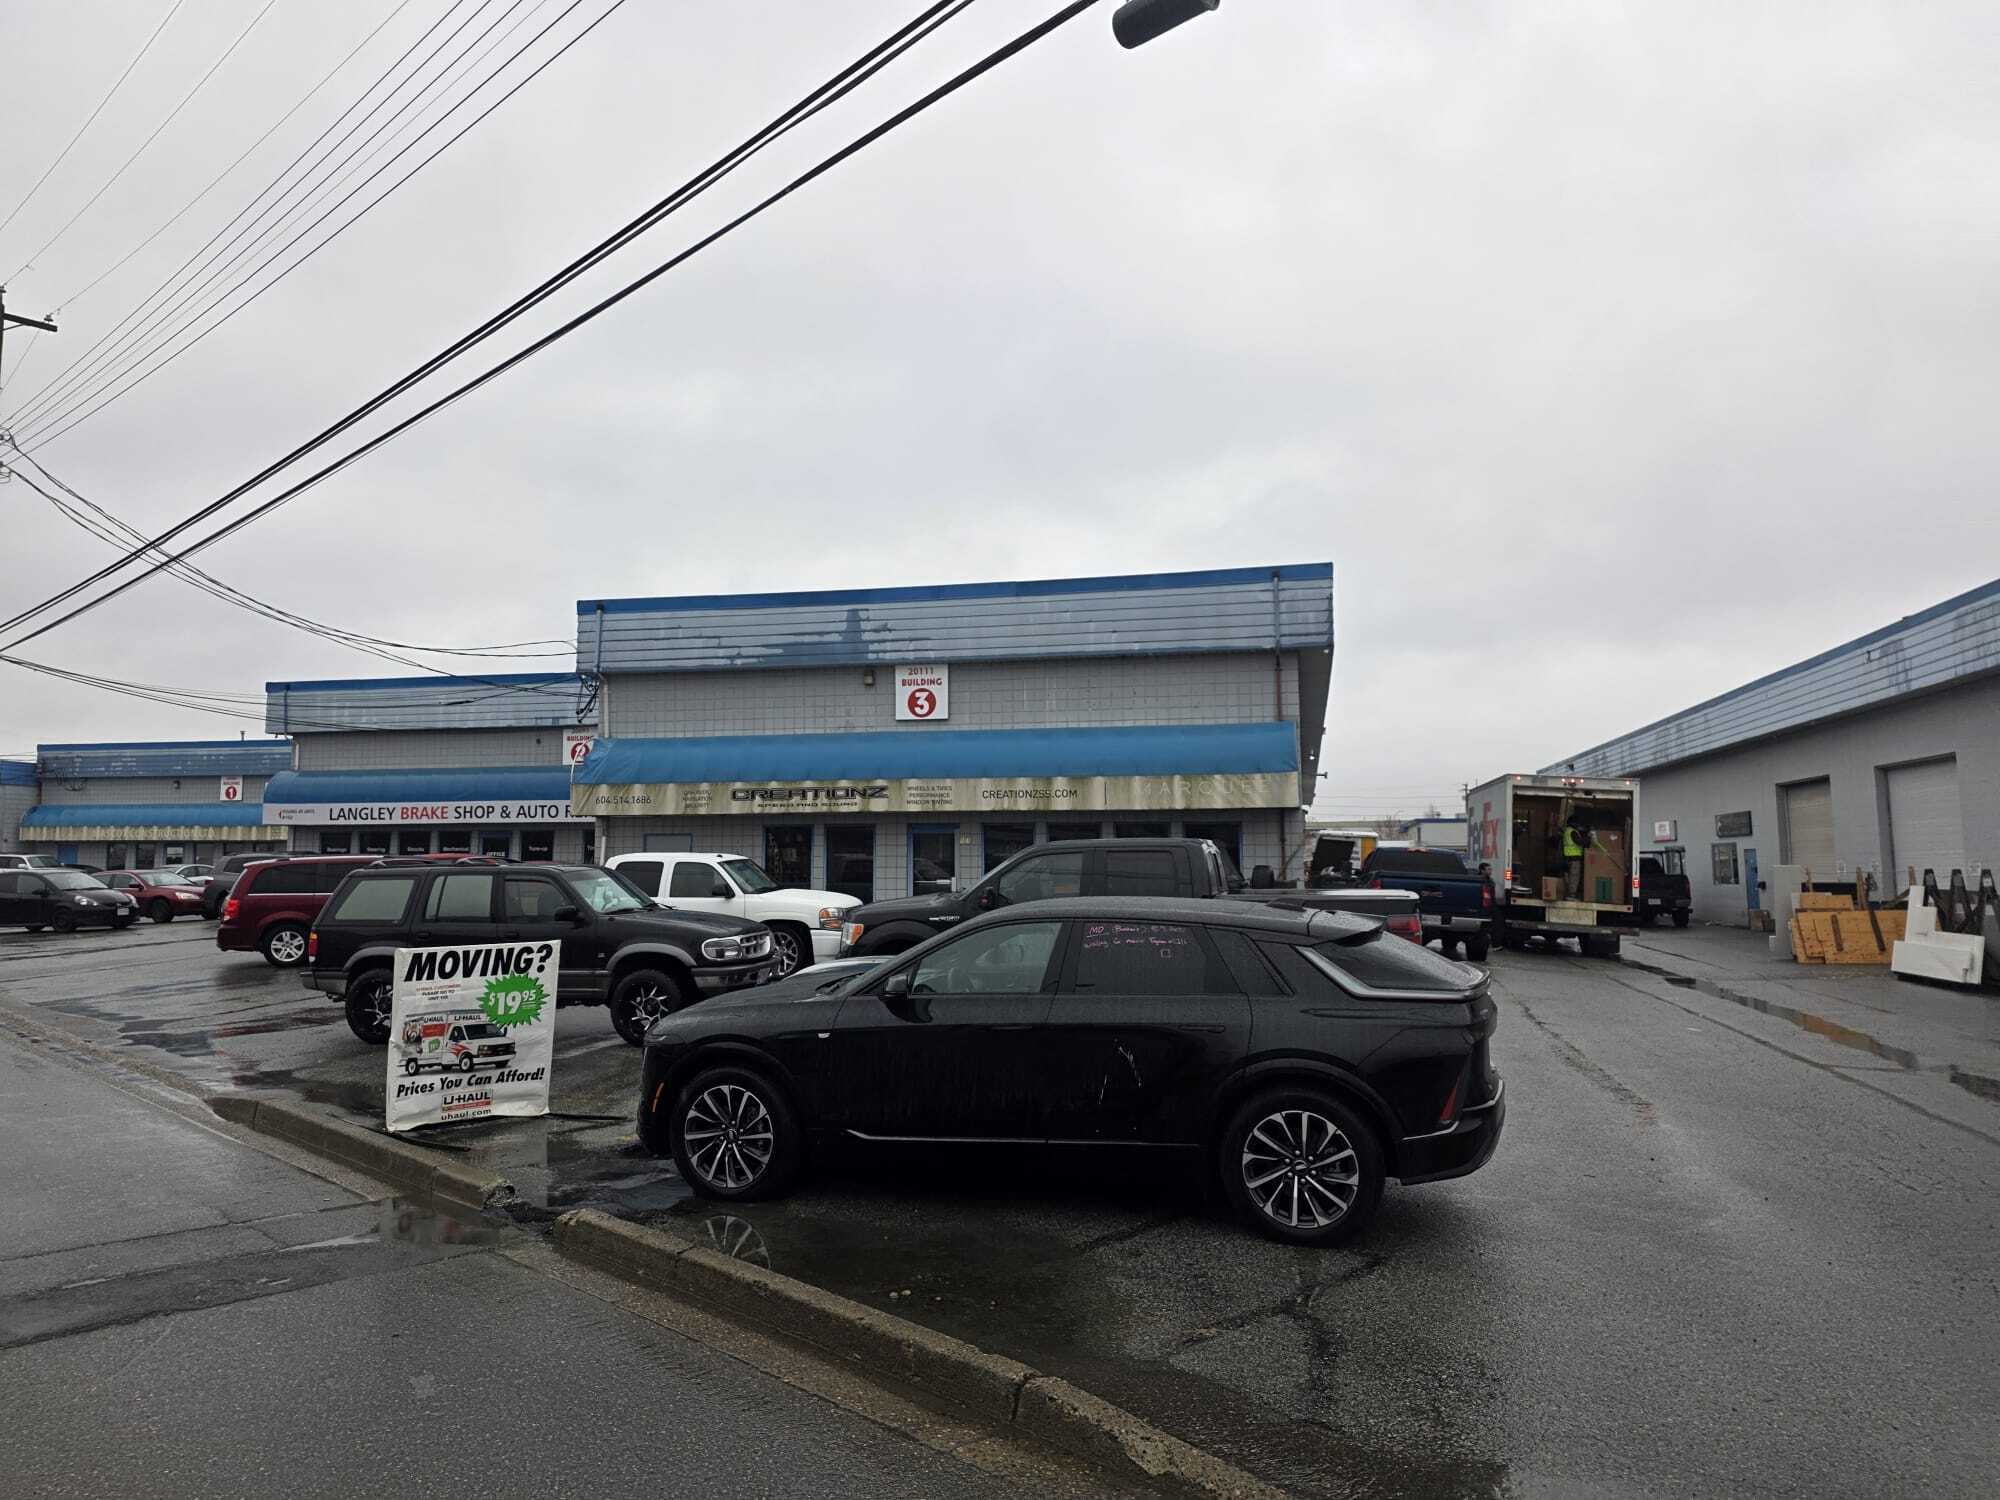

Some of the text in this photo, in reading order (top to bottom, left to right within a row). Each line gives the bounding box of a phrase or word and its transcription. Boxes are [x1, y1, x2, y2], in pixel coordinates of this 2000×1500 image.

[908, 667, 934, 676] 20111
[902, 678, 943, 687] BUILDING
[914, 691, 930, 715] 3
[595, 794, 652, 805] 604.514.1686
[731, 785, 889, 801] CREATIONZ
[329, 807, 396, 821] LANGLEY
[400, 806, 448, 820] BRAKE
[454, 805, 495, 819] SHOP
[500, 805, 511, 818] &
[516, 804, 559, 818] AUTO
[403, 943, 553, 982] MOVING?
[396, 1067, 546, 1098] Prices You Can Afford!
[443, 1091, 491, 1105] U-HAUL
[441, 1108, 492, 1121] uhaul.com
